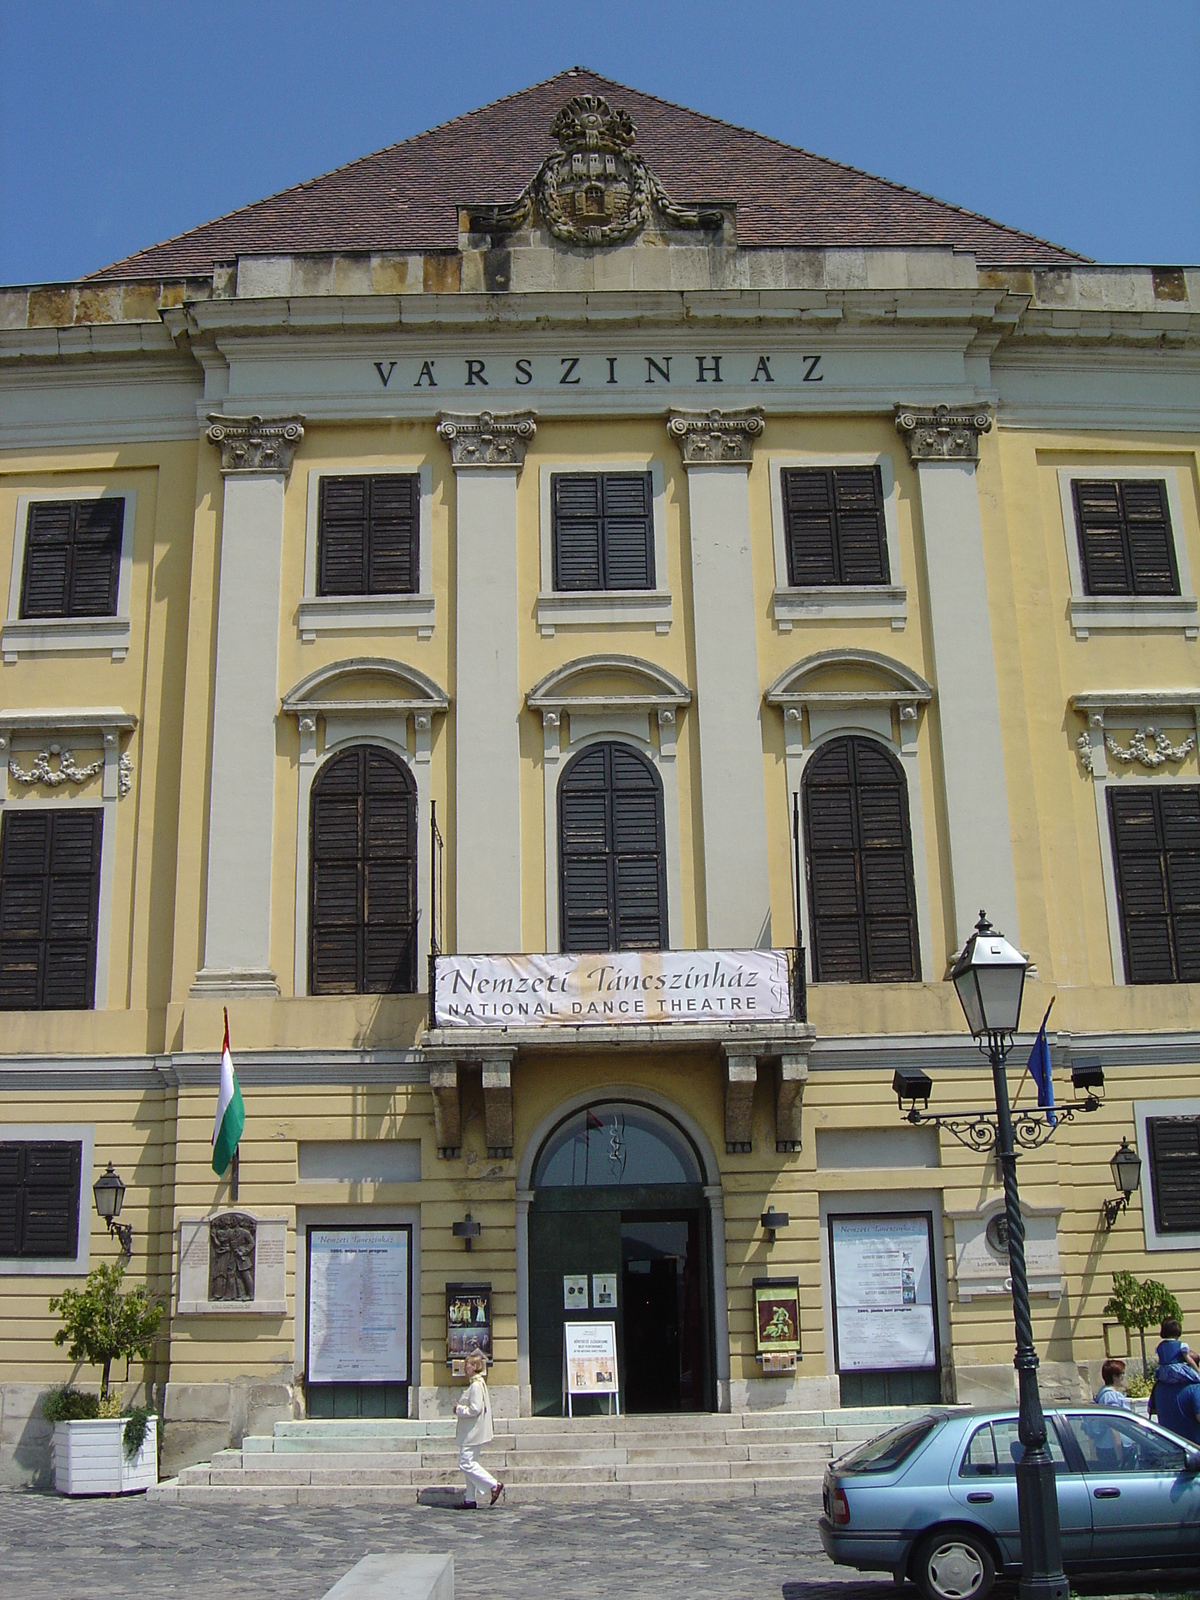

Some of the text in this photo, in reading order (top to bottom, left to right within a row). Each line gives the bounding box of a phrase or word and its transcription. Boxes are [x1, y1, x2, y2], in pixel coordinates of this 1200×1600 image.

[373, 355, 825, 387] VÁRSZINHÁZ
[440, 961, 760, 995] Nemzeti Táncszínház
[448, 996, 758, 1017] NATIONAL DANCE THEATRE
